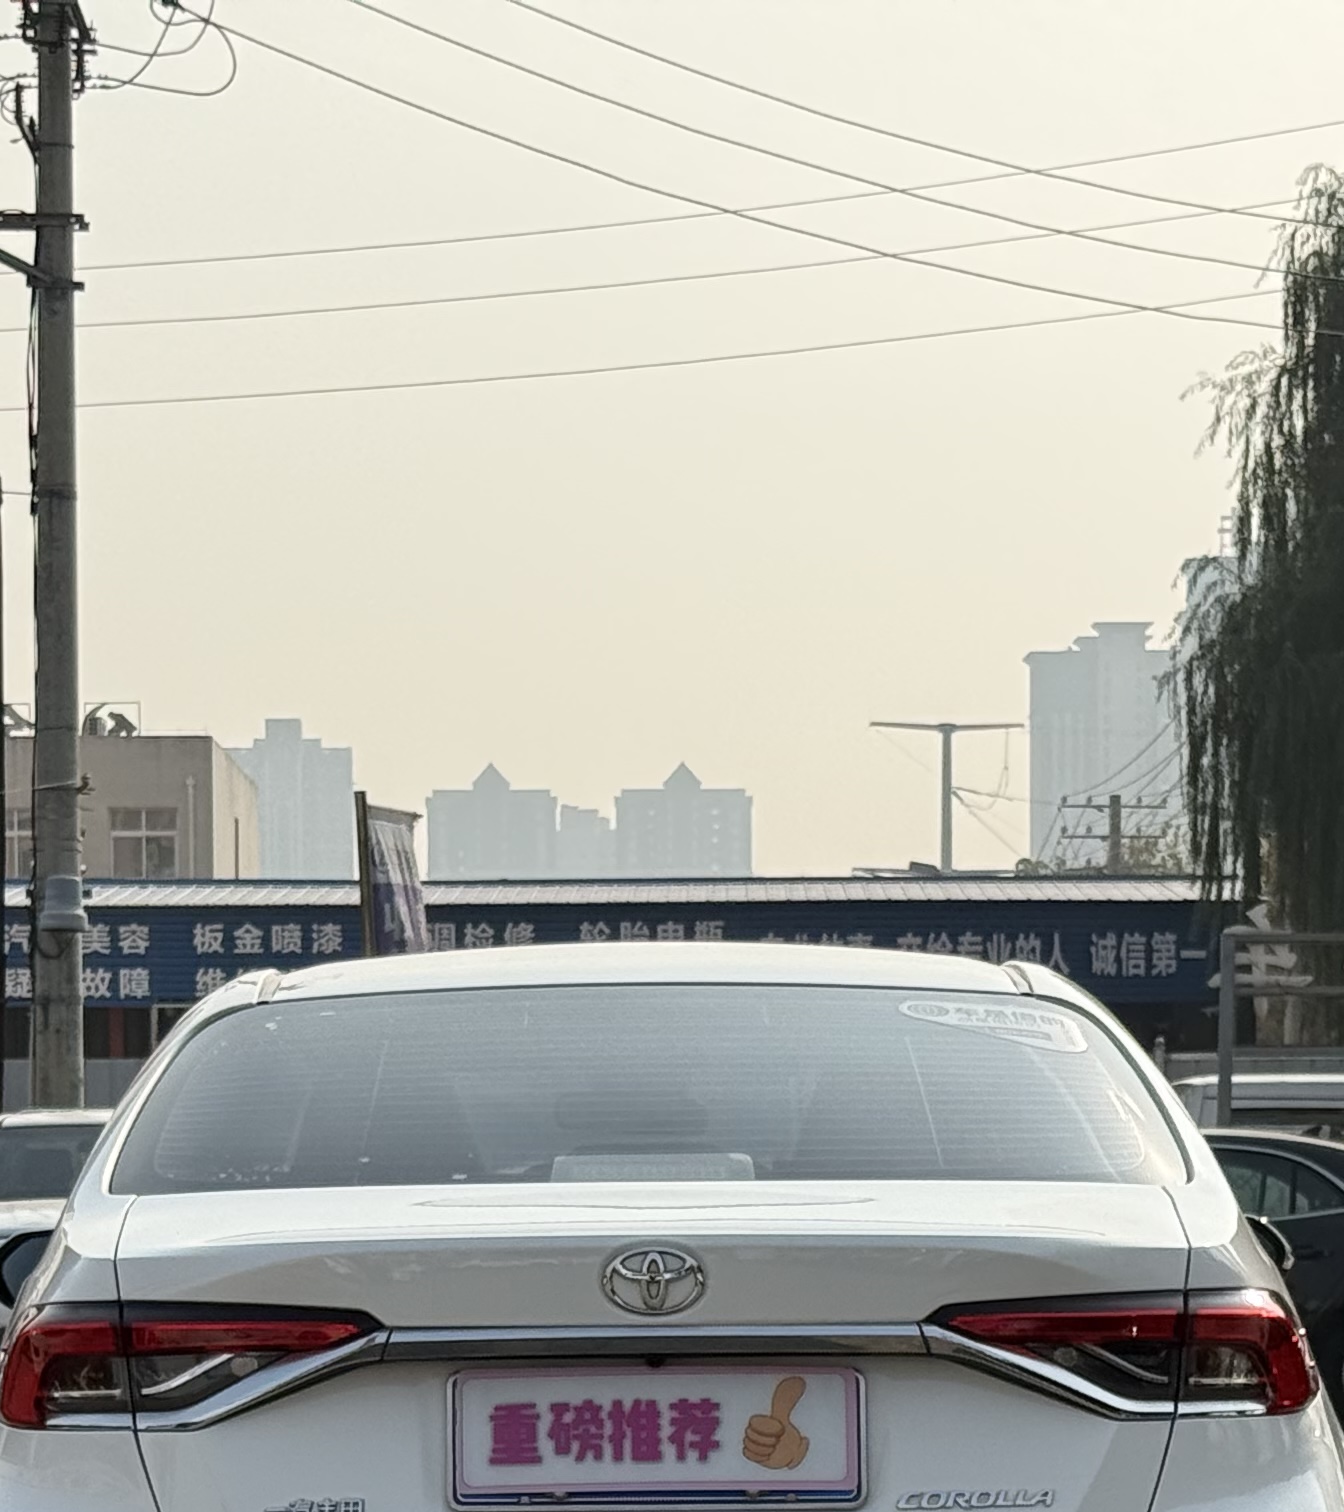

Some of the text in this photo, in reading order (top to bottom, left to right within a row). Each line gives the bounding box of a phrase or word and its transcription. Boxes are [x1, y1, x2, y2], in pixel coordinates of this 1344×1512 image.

[3, 923, 151, 955] 汽美容
[193, 923, 344, 955] 板金喷漆
[424, 922, 535, 951] 调检修
[1089, 932, 1208, 978] 诚信第一
[3, 967, 152, 1000] 疑故障
[488, 1398, 721, 1466] 重磅推荐
[896, 1488, 1055, 1511] COROLLA
